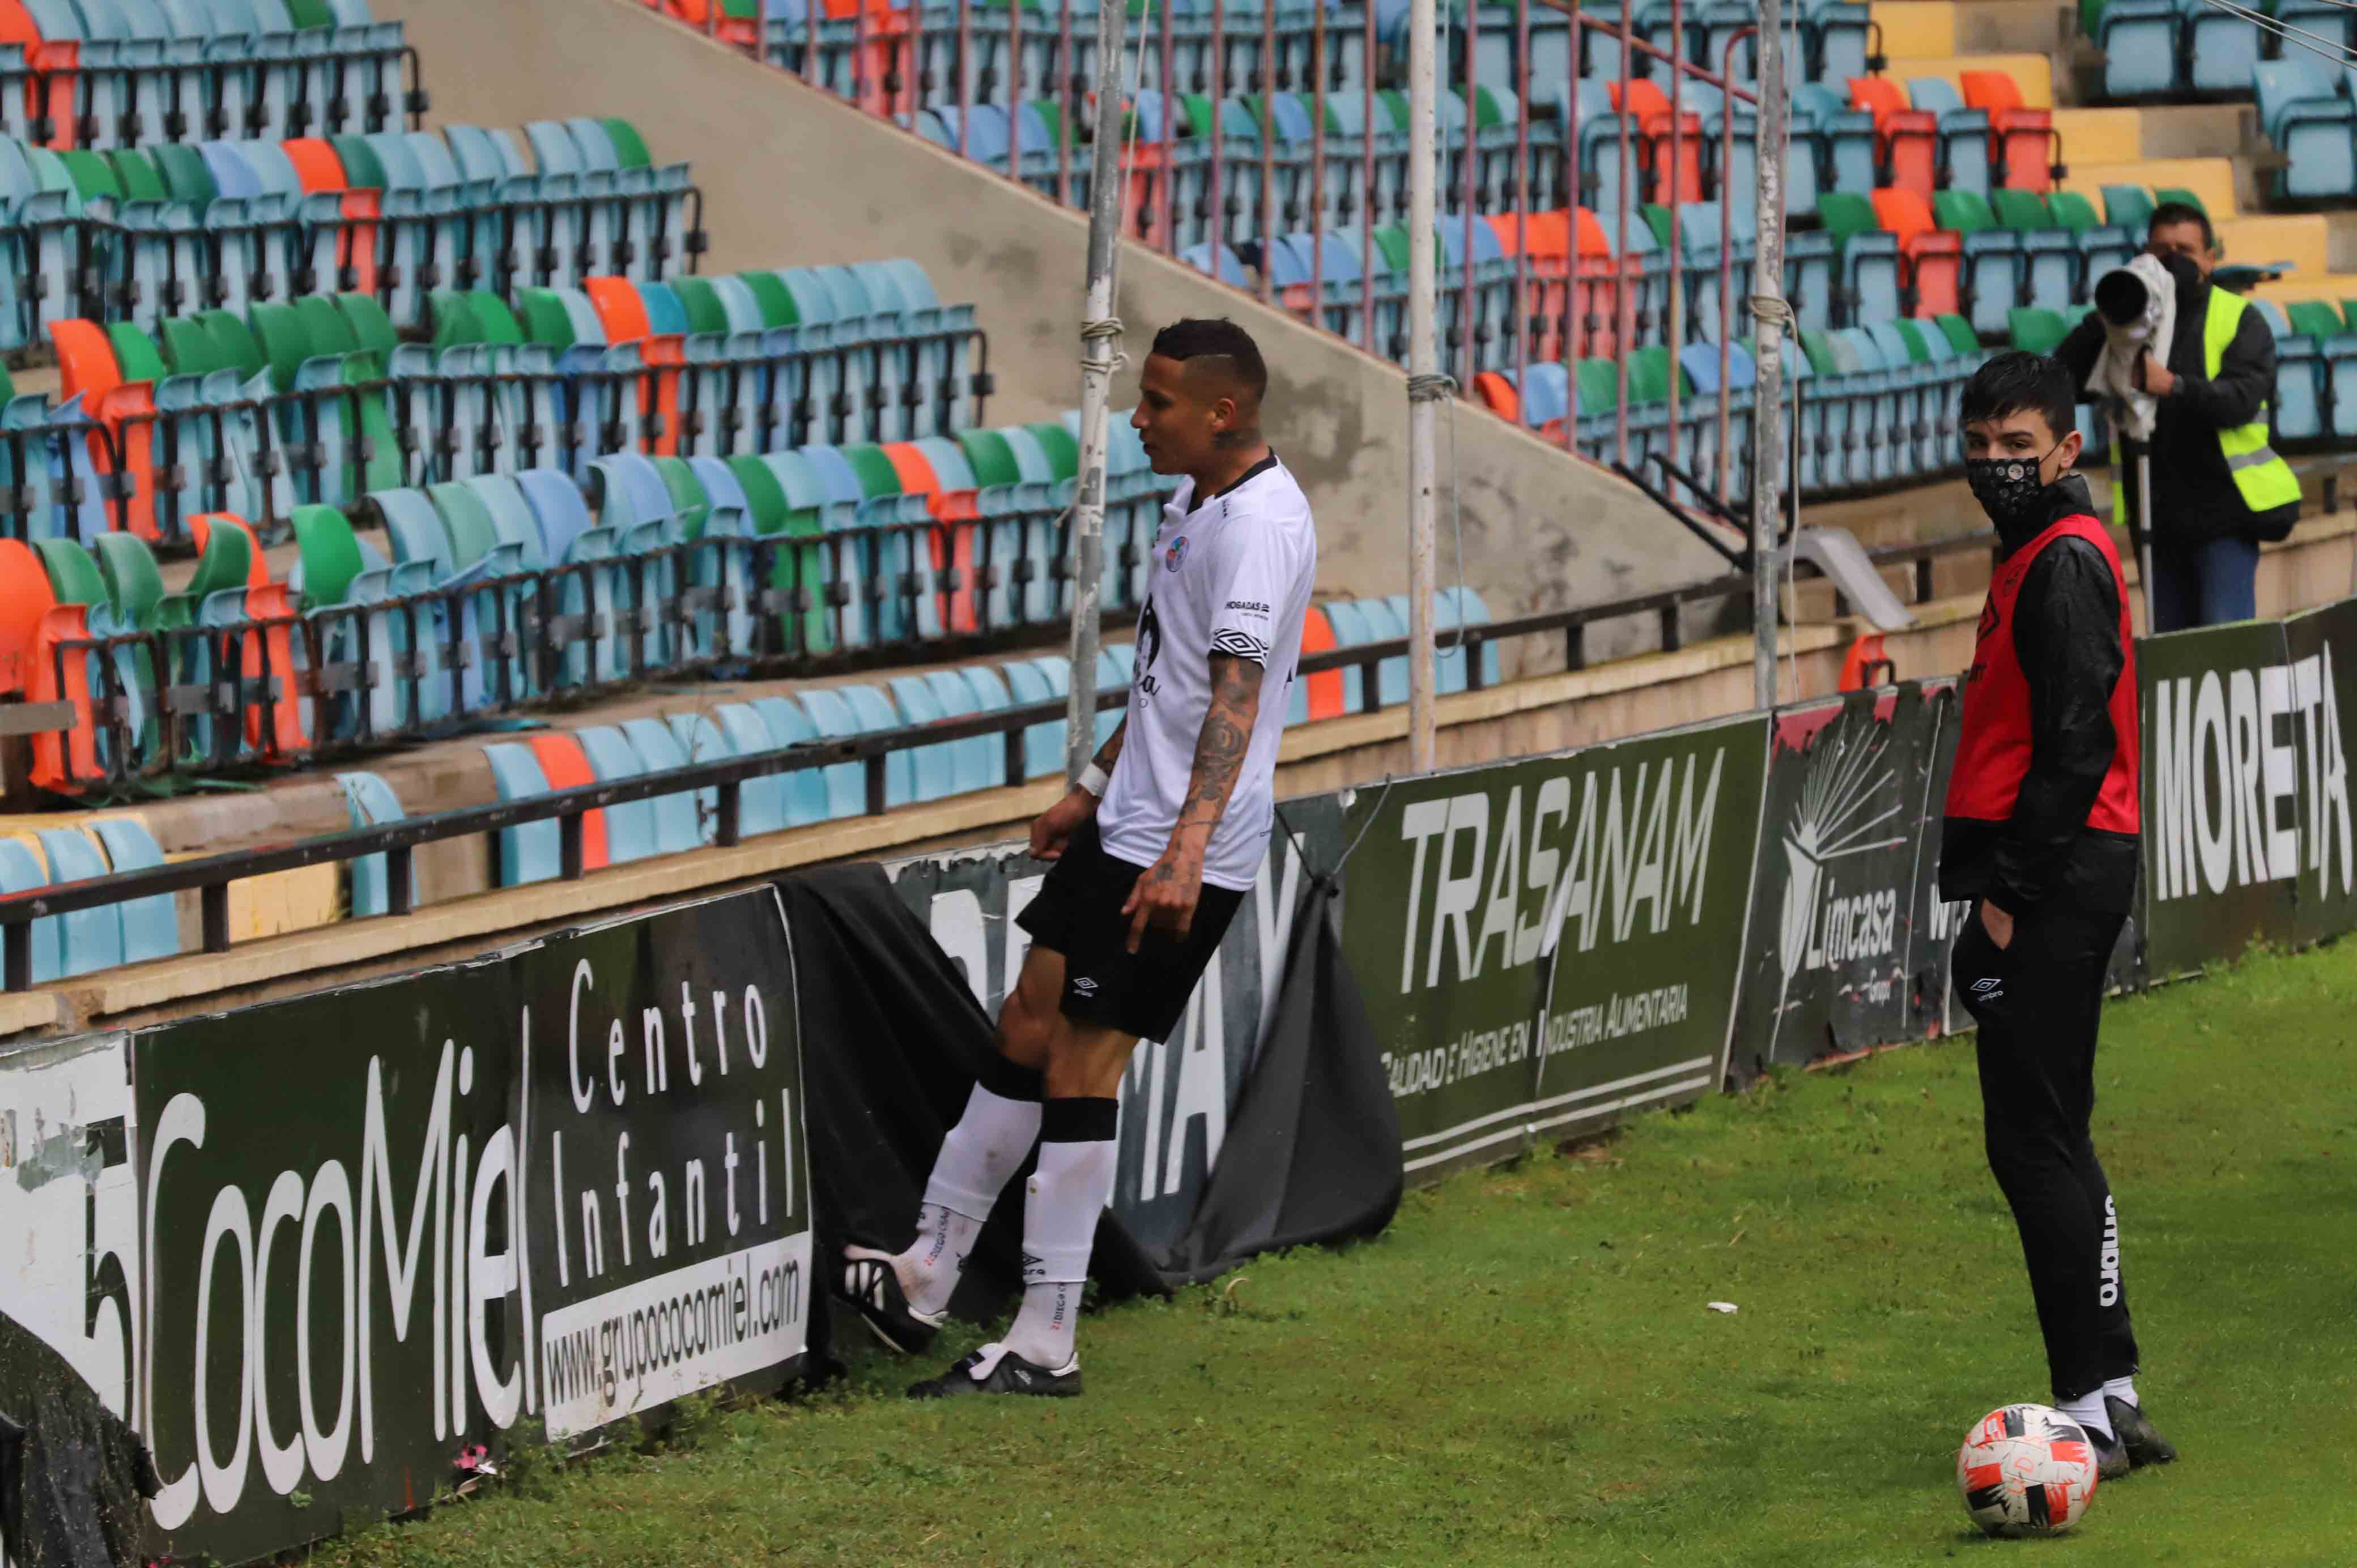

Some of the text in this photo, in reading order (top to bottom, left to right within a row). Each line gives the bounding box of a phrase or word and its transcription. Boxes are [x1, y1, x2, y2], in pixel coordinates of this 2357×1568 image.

[2156, 639, 2353, 902] MORETA
[1401, 746, 1725, 995] TRASANAM
[1805, 866, 1896, 970] Limcasa
[569, 958, 767, 1114] Centro
[1508, 1020, 1531, 1063] EN
[1603, 982, 1687, 1041] ALIMENTARIA
[553, 1088, 793, 1287] Infantil
[2100, 1195, 2119, 1307] umbro
[146, 1004, 535, 1531] CocoMiel
[546, 1252, 799, 1407] www.grupococomiel.com
